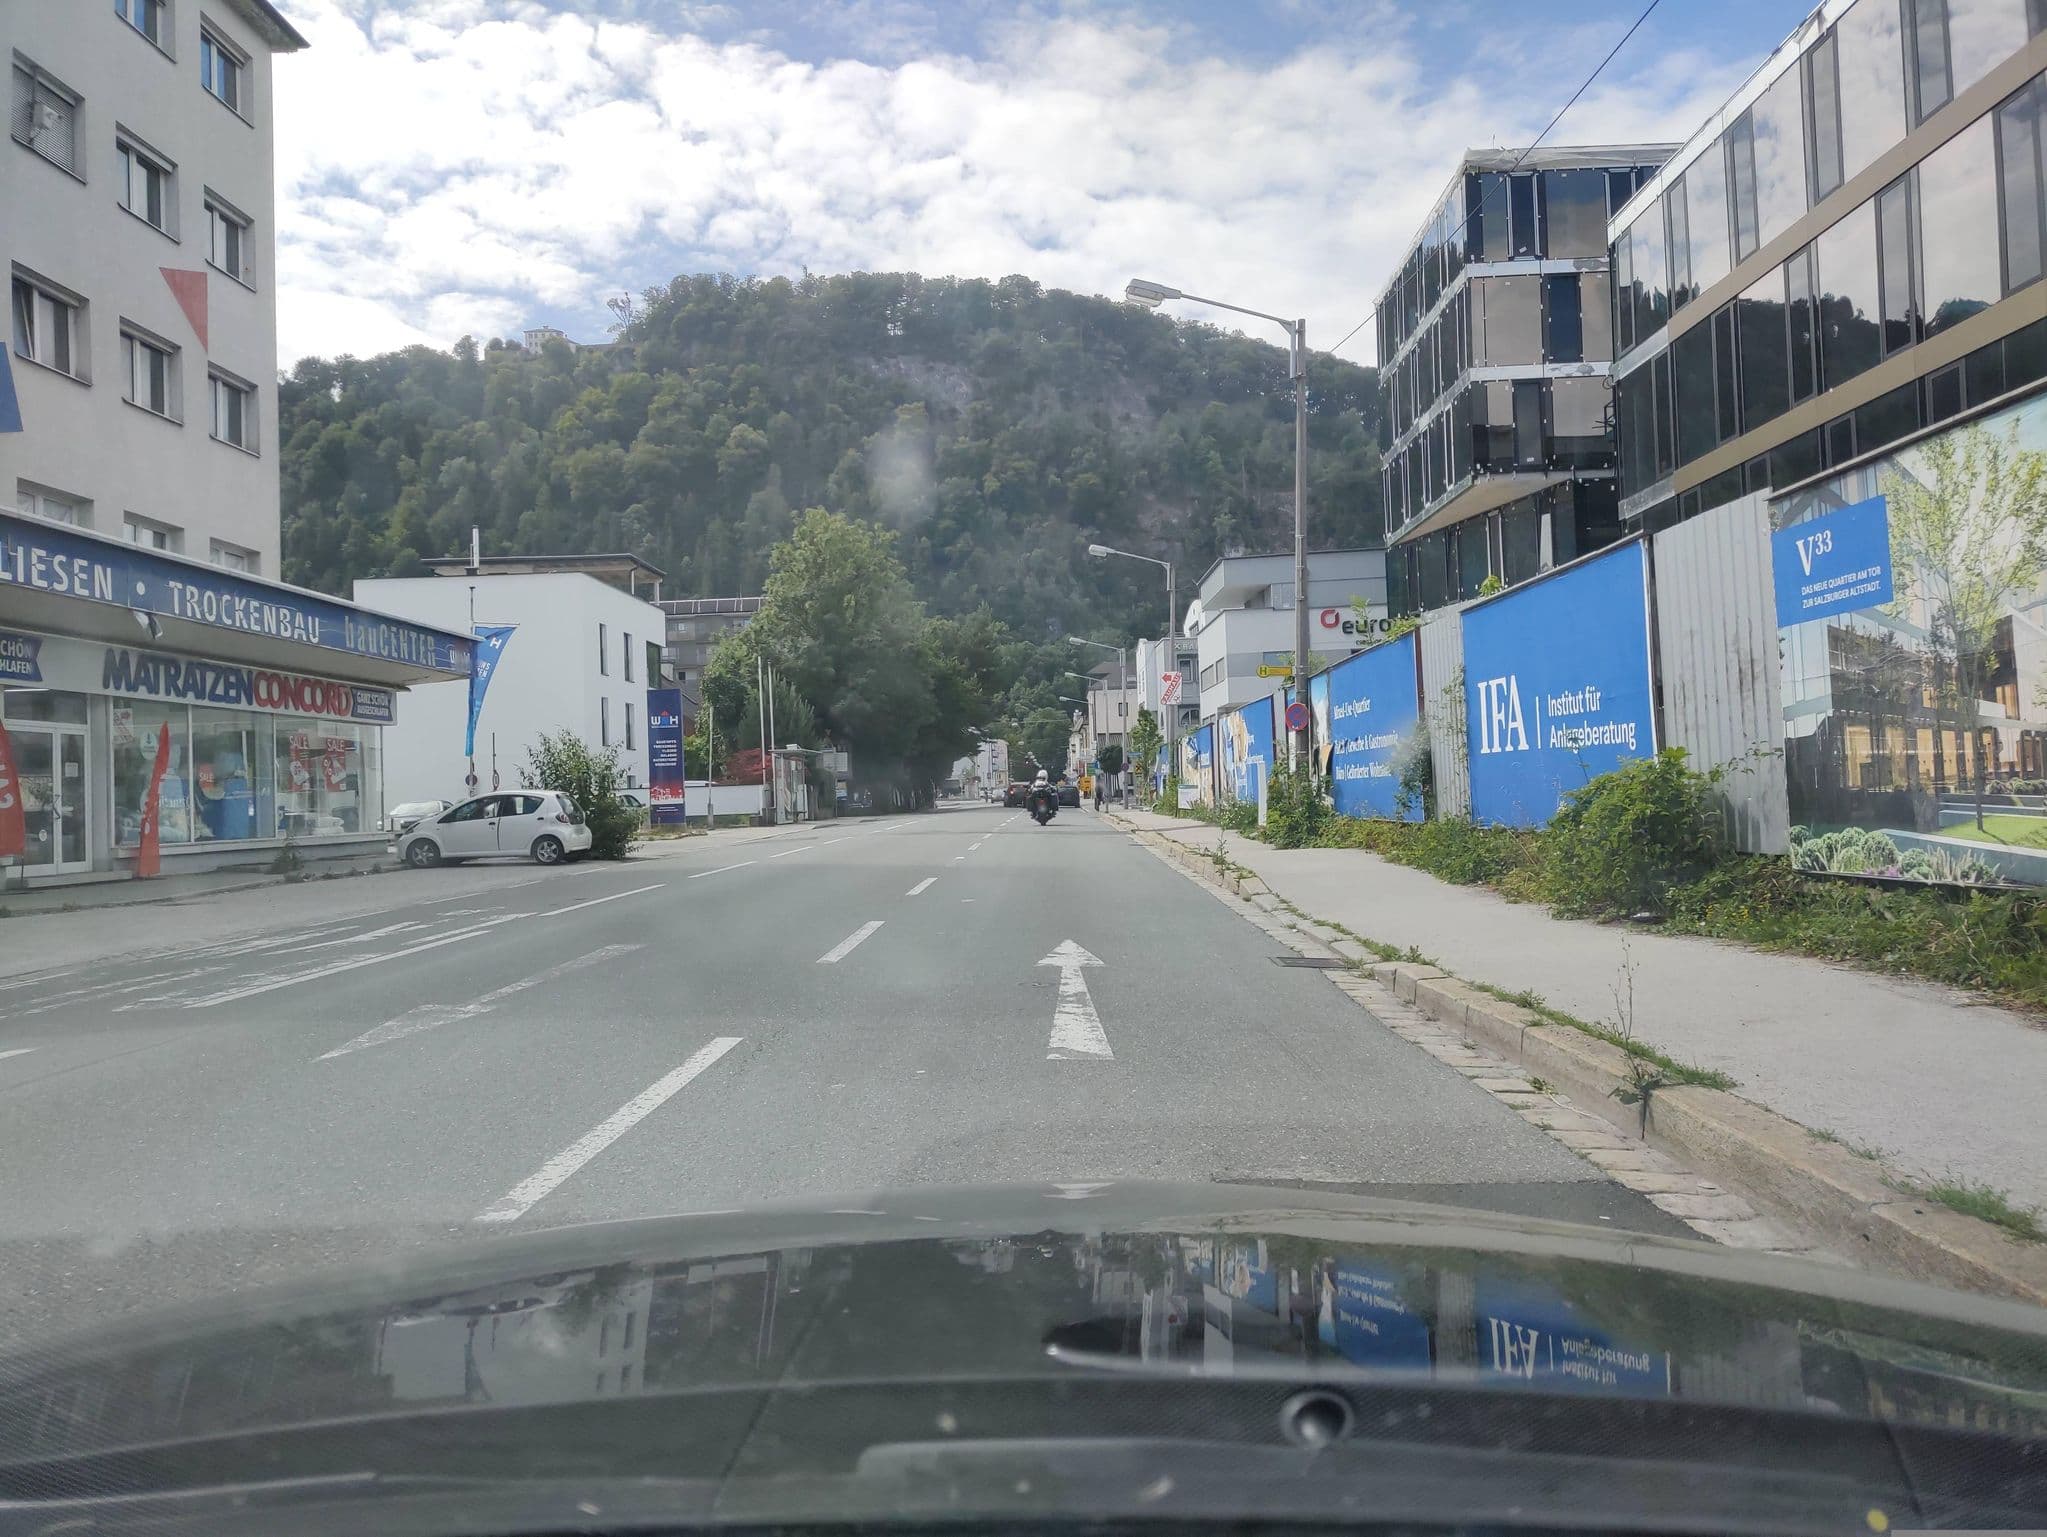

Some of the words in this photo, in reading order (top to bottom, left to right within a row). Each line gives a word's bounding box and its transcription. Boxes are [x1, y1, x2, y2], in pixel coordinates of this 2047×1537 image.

[1801, 584, 1814, 596] DAS
[1814, 581, 1828, 592] NEUE
[1828, 571, 1857, 588] QUARTIER
[1857, 570, 1868, 580] AM
[1868, 566, 1882, 577] TOR
[167, 580, 321, 644] TROCKENBAU
[1802, 598, 1814, 609] ZUR
[1814, 588, 1850, 606] SALZBURGER
[1477, 674, 1529, 754] IFA
[1547, 689, 1584, 717] Institut
[1584, 685, 1602, 713] für
[290, 735, 310, 750] SALE
[326, 738, 345, 752] SALE
[1550, 720, 1637, 754] Anlageberatung
